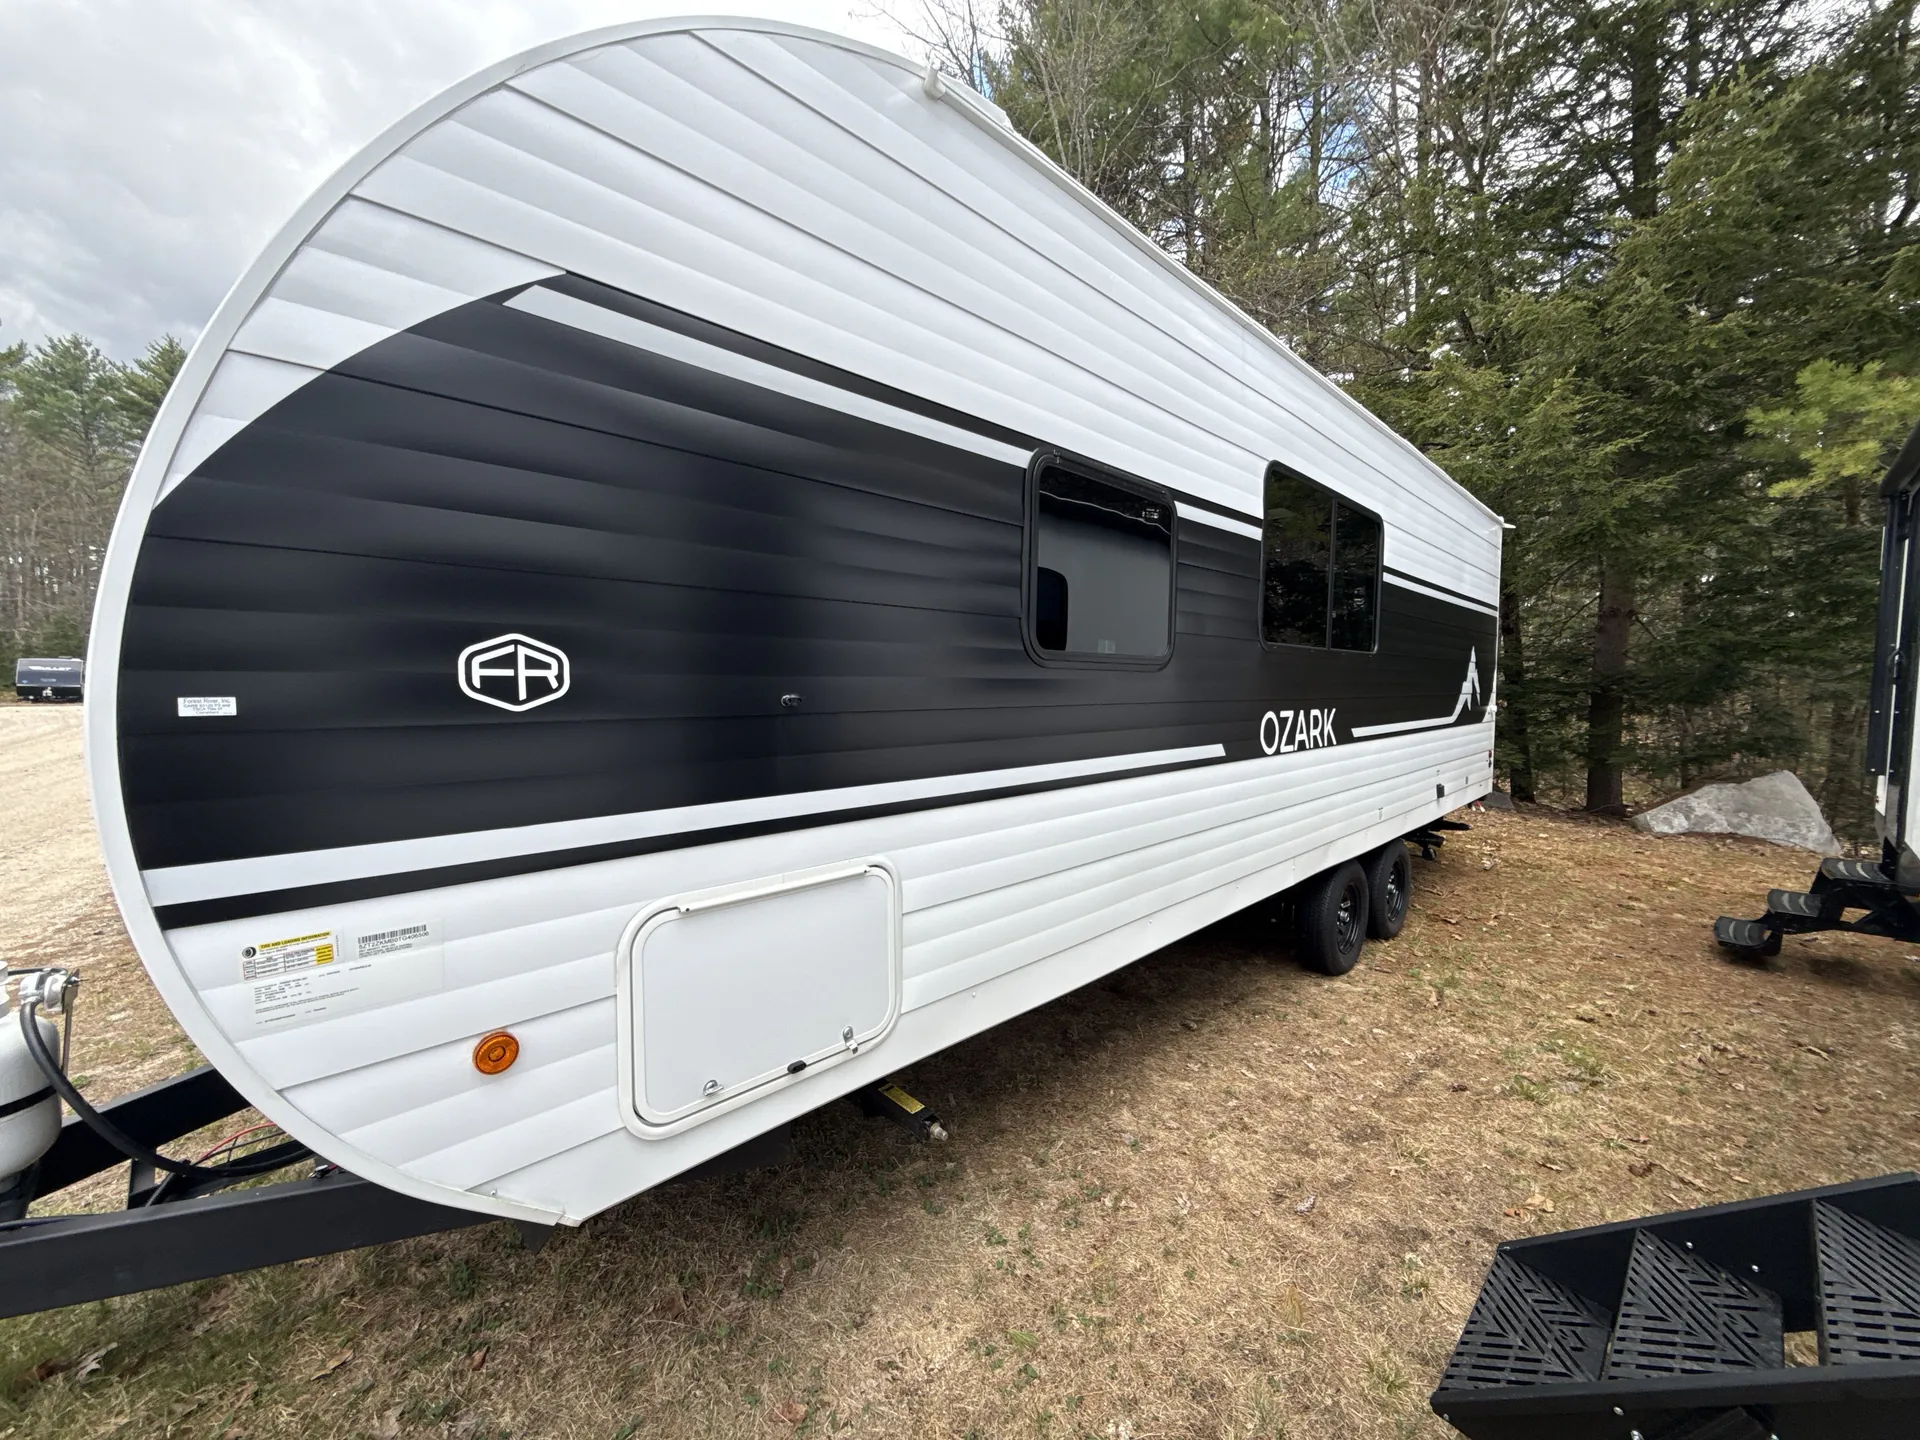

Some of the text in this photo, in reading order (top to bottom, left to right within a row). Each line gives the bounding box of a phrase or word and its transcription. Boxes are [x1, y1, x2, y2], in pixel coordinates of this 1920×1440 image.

[471, 643, 559, 701] FR
[1259, 707, 1337, 756] OZARK
[281, 937, 301, 945] LOADING
[301, 931, 330, 942] INFORMATION
